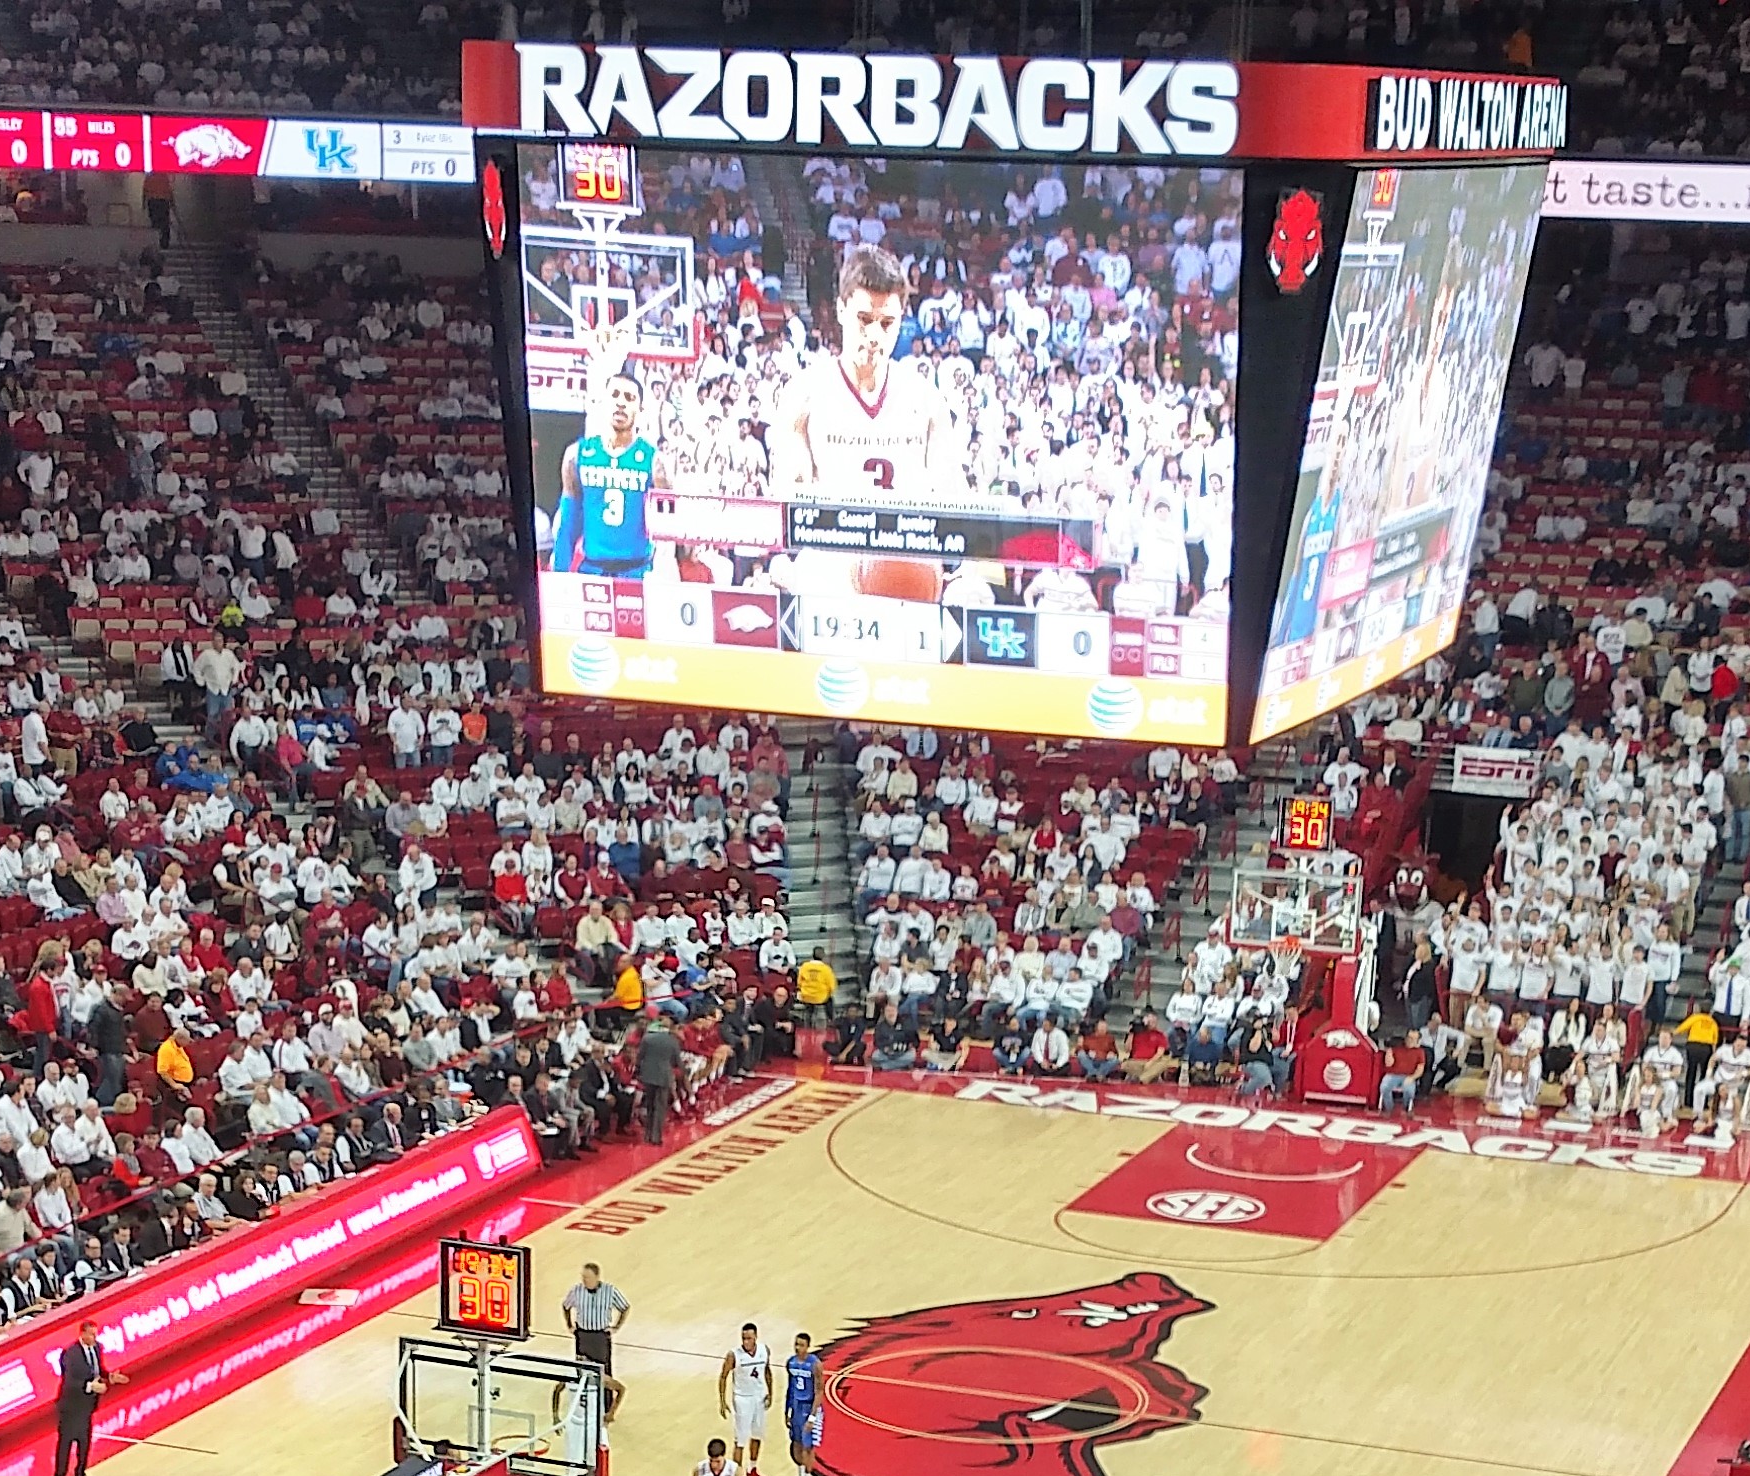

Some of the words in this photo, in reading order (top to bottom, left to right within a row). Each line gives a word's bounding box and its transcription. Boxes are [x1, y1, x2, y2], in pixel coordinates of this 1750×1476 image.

[517, 43, 1239, 155] RAZORBACKS
[1377, 76, 1433, 150] BUD
[1438, 78, 1519, 149] WALTON
[1517, 83, 1567, 147] ARENA
[54, 116, 78, 137] 55
[393, 130, 402, 145] 3
[11, 139, 28, 164] 0
[71, 148, 100, 166] PTS
[115, 143, 132, 167] 0
[411, 161, 436, 175] PTS
[445, 158, 457, 177] 0
[574, 164, 621, 201] 30
[603, 488, 625, 527] 3
[680, 602, 694, 627] 0
[812, 614, 879, 641] 19:34
[1073, 630, 1092, 657] 0
[1460, 756, 1533, 780] ESPN
[1292, 801, 1328, 817] 19:34
[1291, 817, 1323, 845] 30
[955, 1080, 1708, 1176] RAZORBACKS
[564, 1200, 667, 1235] BUD
[631, 1134, 785, 1195] WALTON
[752, 1089, 867, 1134] ARENA
[1156, 1194, 1257, 1220] SEC
[453, 1251, 518, 1279] 19:34
[121, 1305, 171, 1342] Place
[167, 1295, 190, 1320] to
[187, 1281, 220, 1312] Get
[459, 1277, 510, 1325] 30
